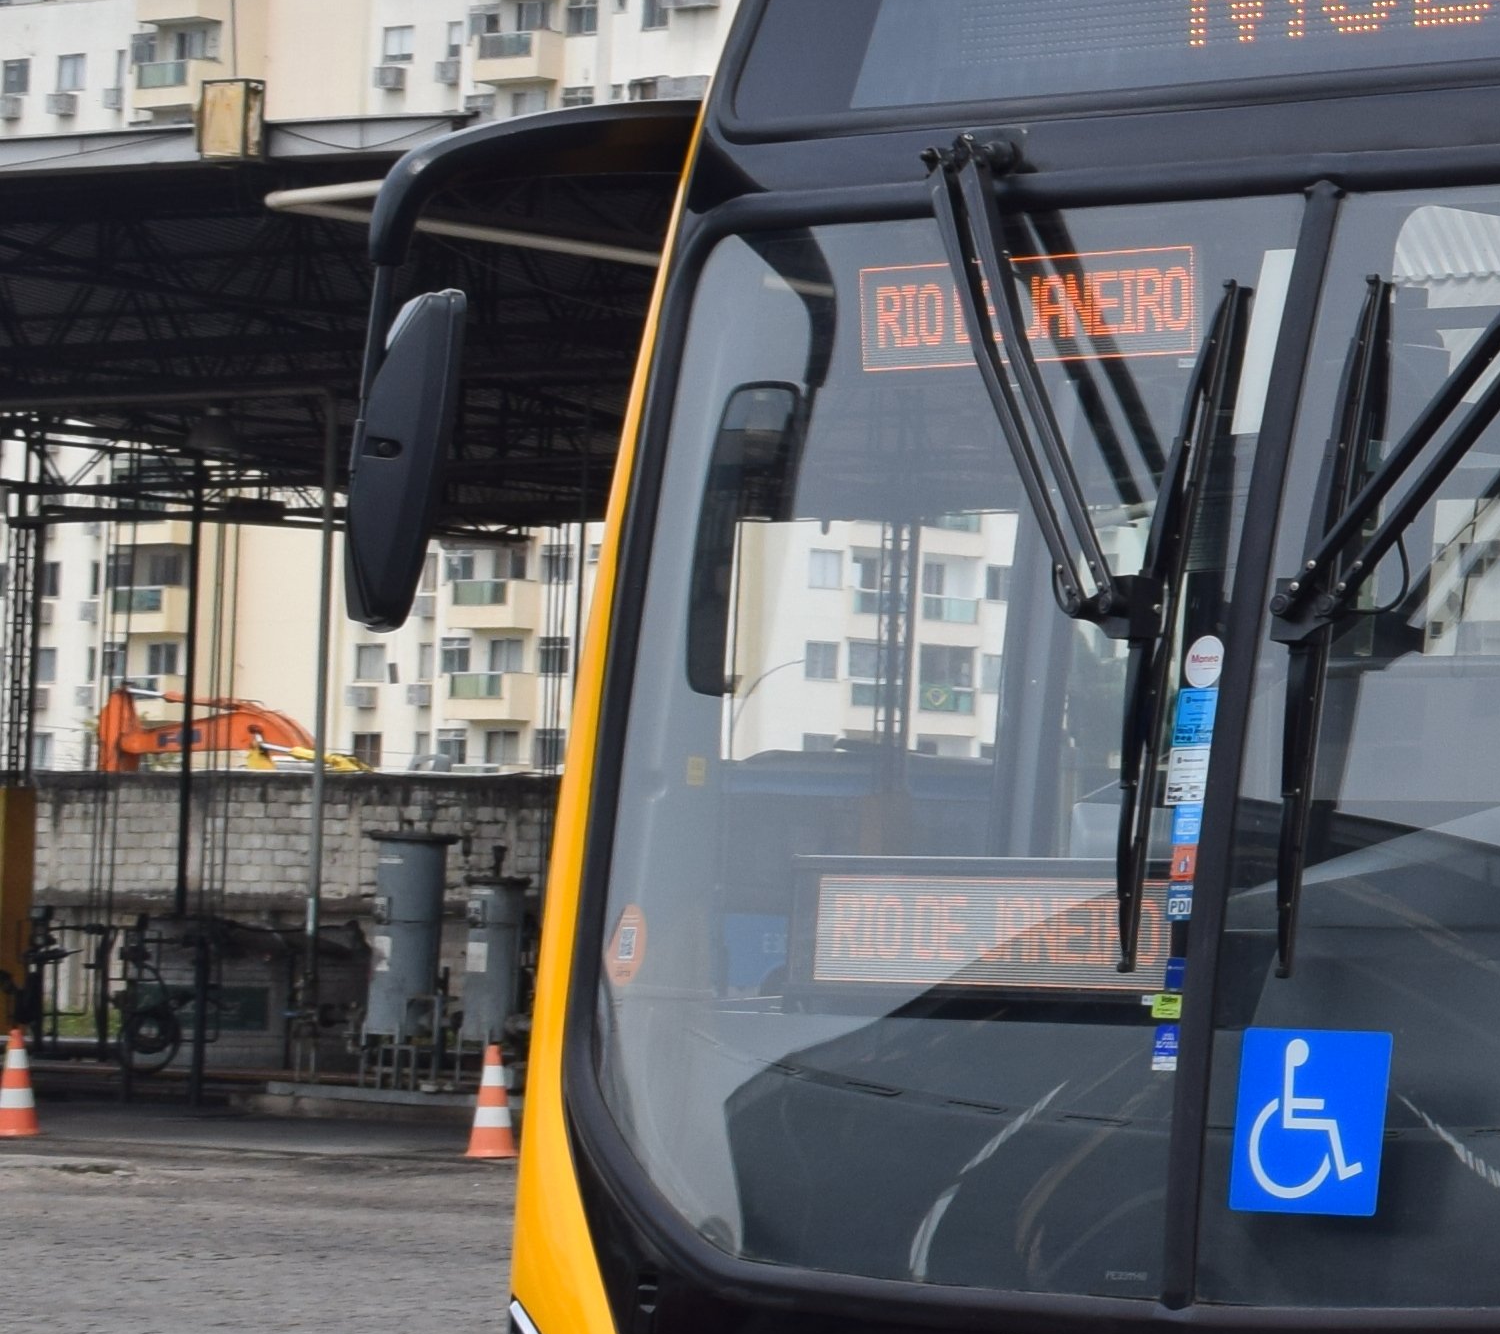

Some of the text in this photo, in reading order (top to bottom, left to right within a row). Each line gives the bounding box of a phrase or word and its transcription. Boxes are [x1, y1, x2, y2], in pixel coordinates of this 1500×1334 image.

[876, 283, 943, 348] RIO
[1025, 266, 1190, 340] JANEIRO
[831, 893, 901, 960] RIO
[911, 894, 967, 960] DE
[1169, 899, 1191, 914] PDI
